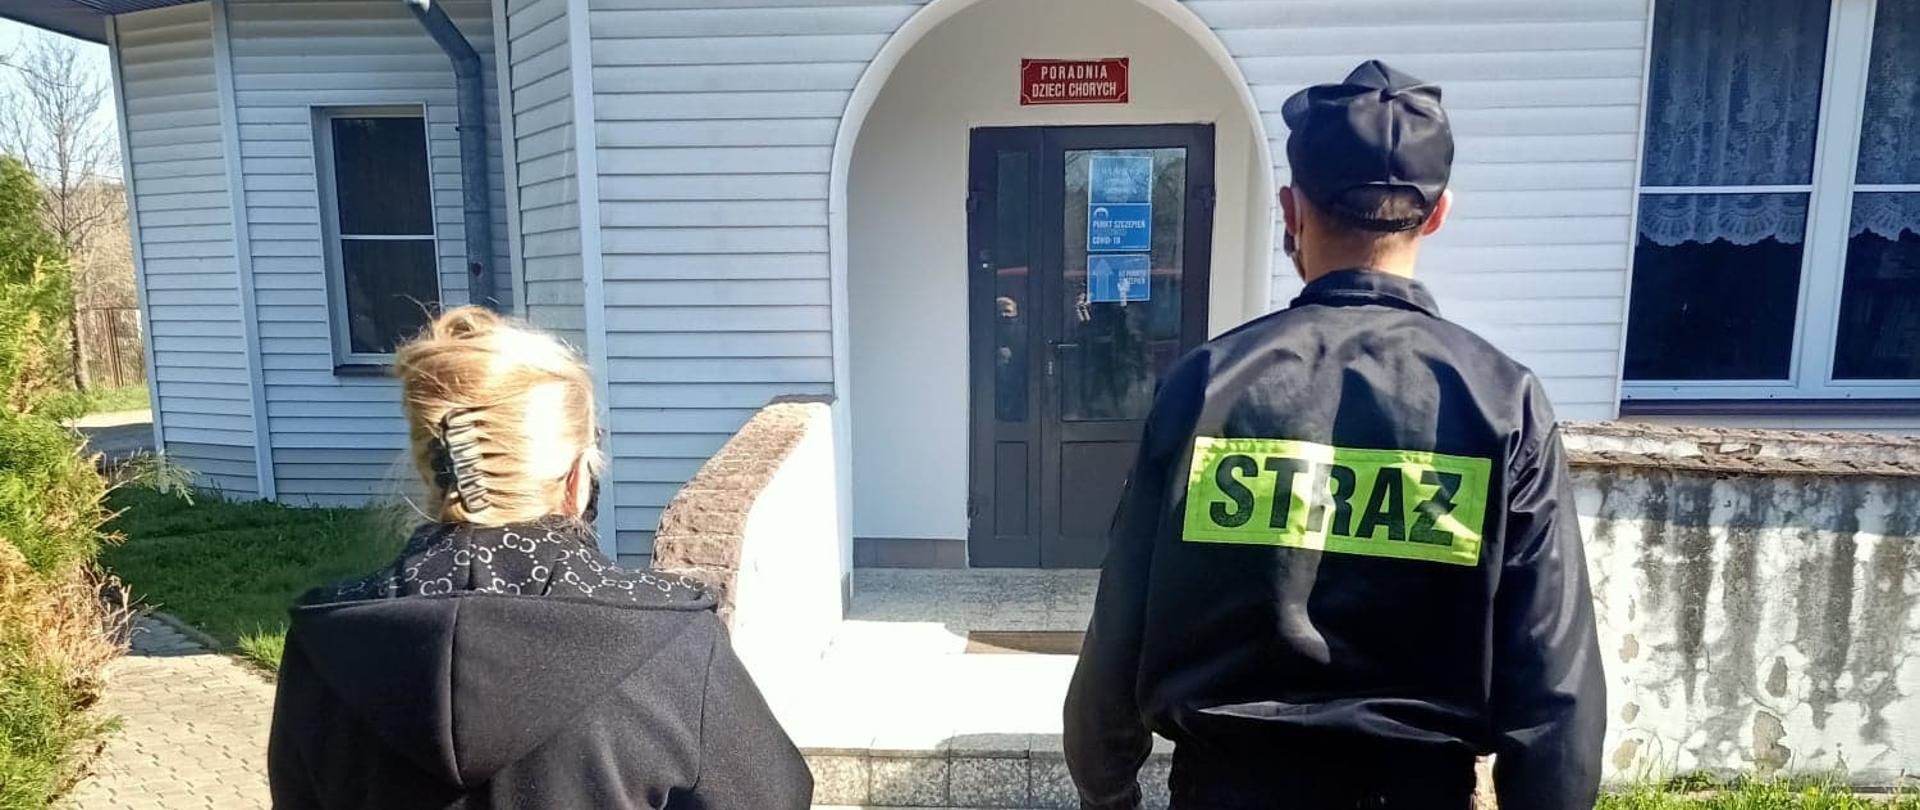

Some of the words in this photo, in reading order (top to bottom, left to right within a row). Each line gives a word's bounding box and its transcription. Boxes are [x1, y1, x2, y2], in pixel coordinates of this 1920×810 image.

[1041, 65, 1108, 79] PORADNIA
[1032, 83, 1066, 97] DZIECI
[1069, 81, 1116, 96] CHORYCH
[1093, 220, 1112, 228] PUNKT
